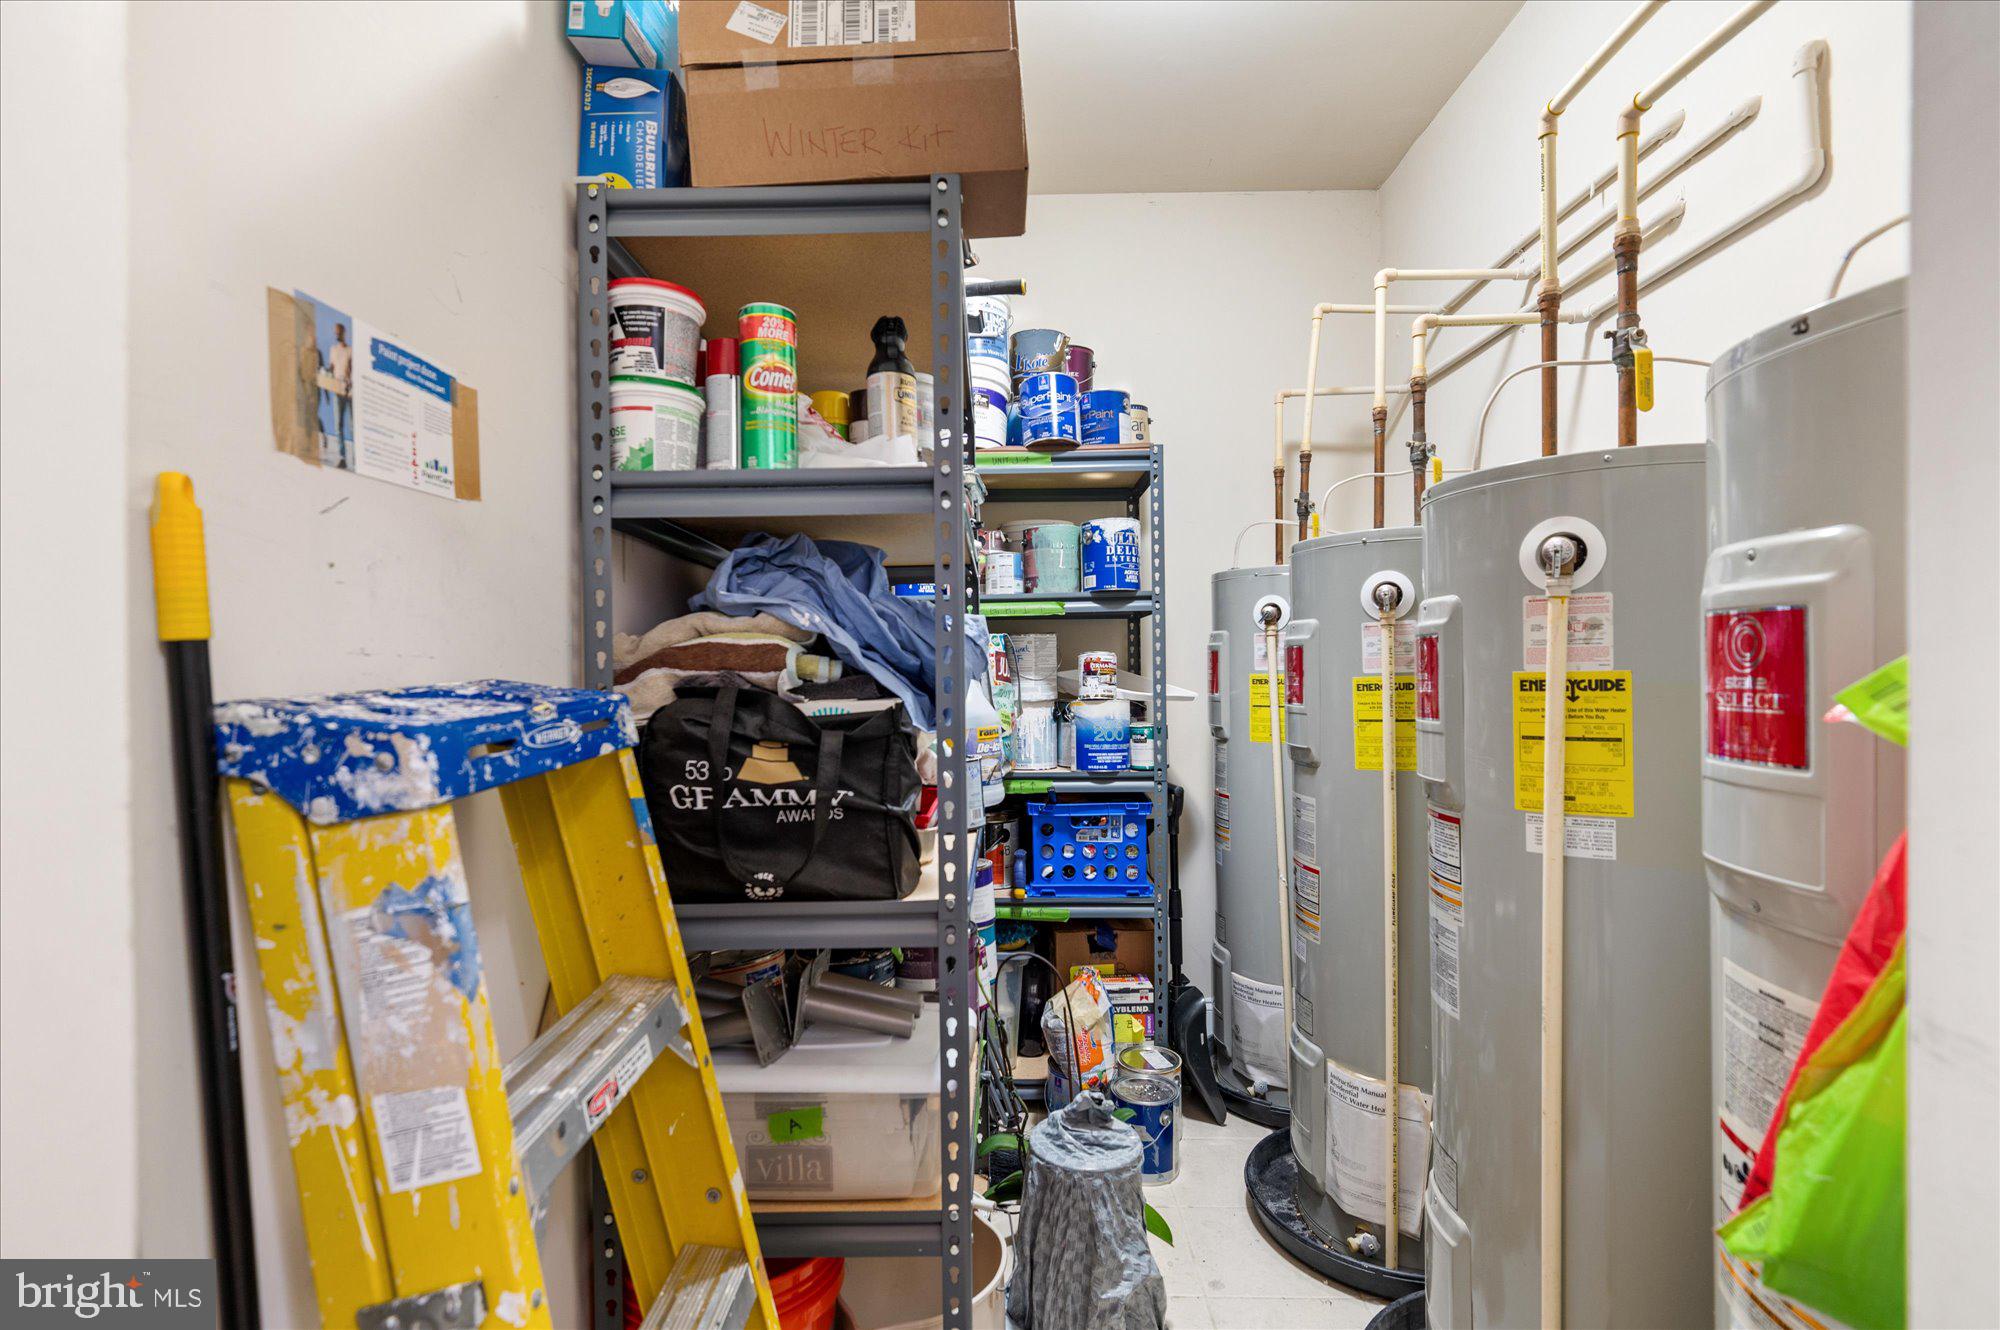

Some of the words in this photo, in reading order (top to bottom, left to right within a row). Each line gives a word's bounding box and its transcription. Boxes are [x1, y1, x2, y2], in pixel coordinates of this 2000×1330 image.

[763, 117, 883, 160] WINTER
[762, 316, 785, 330] 20%
[757, 326, 790, 341] MORE
[750, 366, 796, 392] Comet
[1022, 392, 1072, 408] SuperPaint
[1356, 683, 1414, 692] ENERGUID
[1519, 678, 1626, 693] ENEYGUIDE
[1715, 692, 1779, 710] SELECT
[1094, 728, 1124, 742] 200
[776, 808, 844, 824] AWAS
[1113, 1006, 1149, 1014] LYBLEND
[1329, 1080, 1359, 1099] Residential
[1330, 1072, 1360, 1092] Instruction
[1360, 1087, 1386, 1099] Manual
[1329, 1086, 1348, 1102] Electric
[1349, 1097, 1369, 1110] Water
[790, 1118, 802, 1135] A
[754, 1150, 824, 1182] villa
